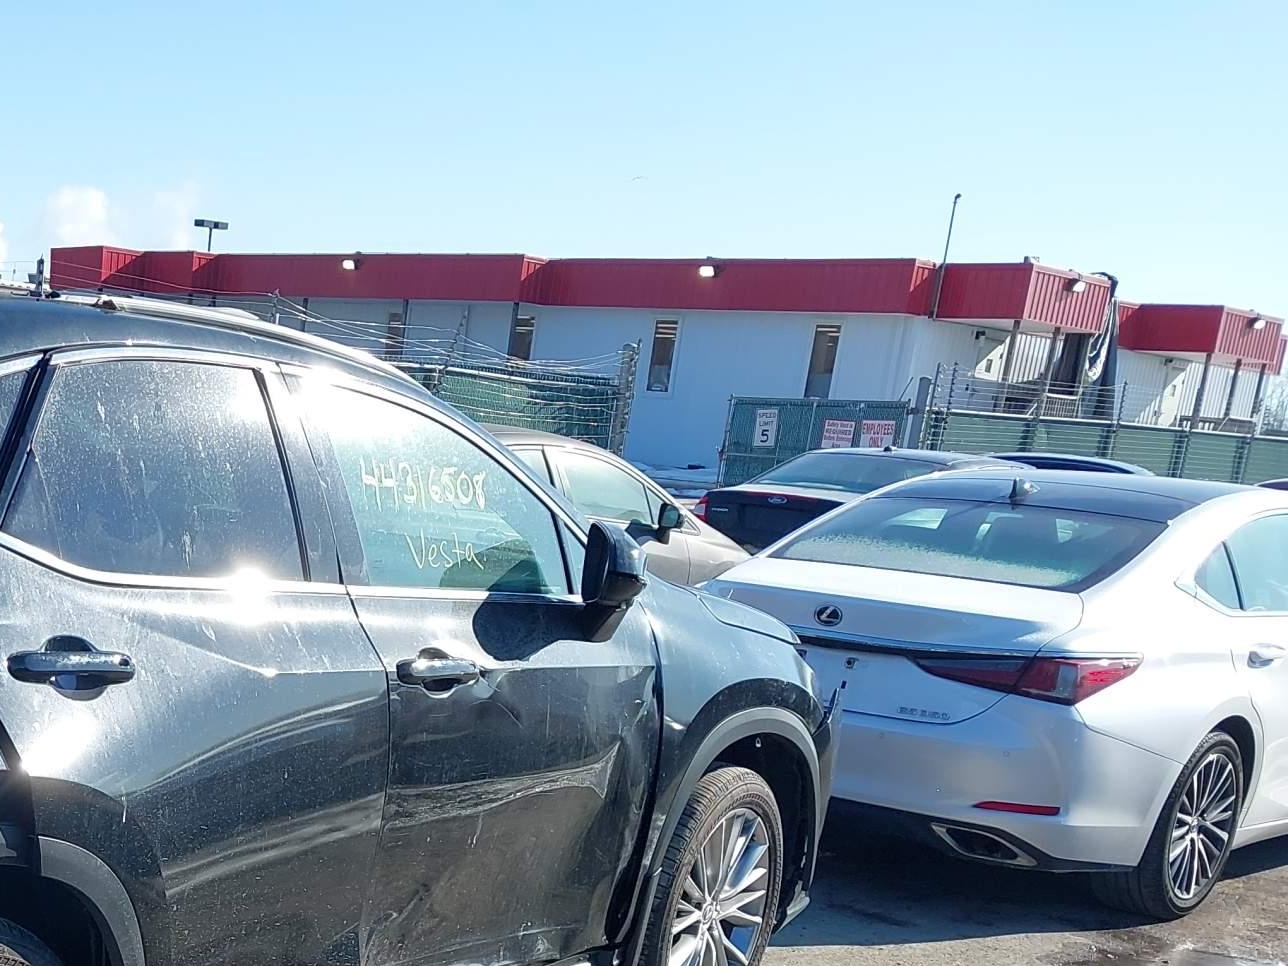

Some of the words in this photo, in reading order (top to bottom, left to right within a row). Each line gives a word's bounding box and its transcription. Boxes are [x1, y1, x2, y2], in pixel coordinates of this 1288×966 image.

[862, 423, 894, 435] EMPLOYEES
[760, 429, 769, 443] 5
[869, 436, 884, 448] ONLY
[359, 457, 487, 512] 44316508
